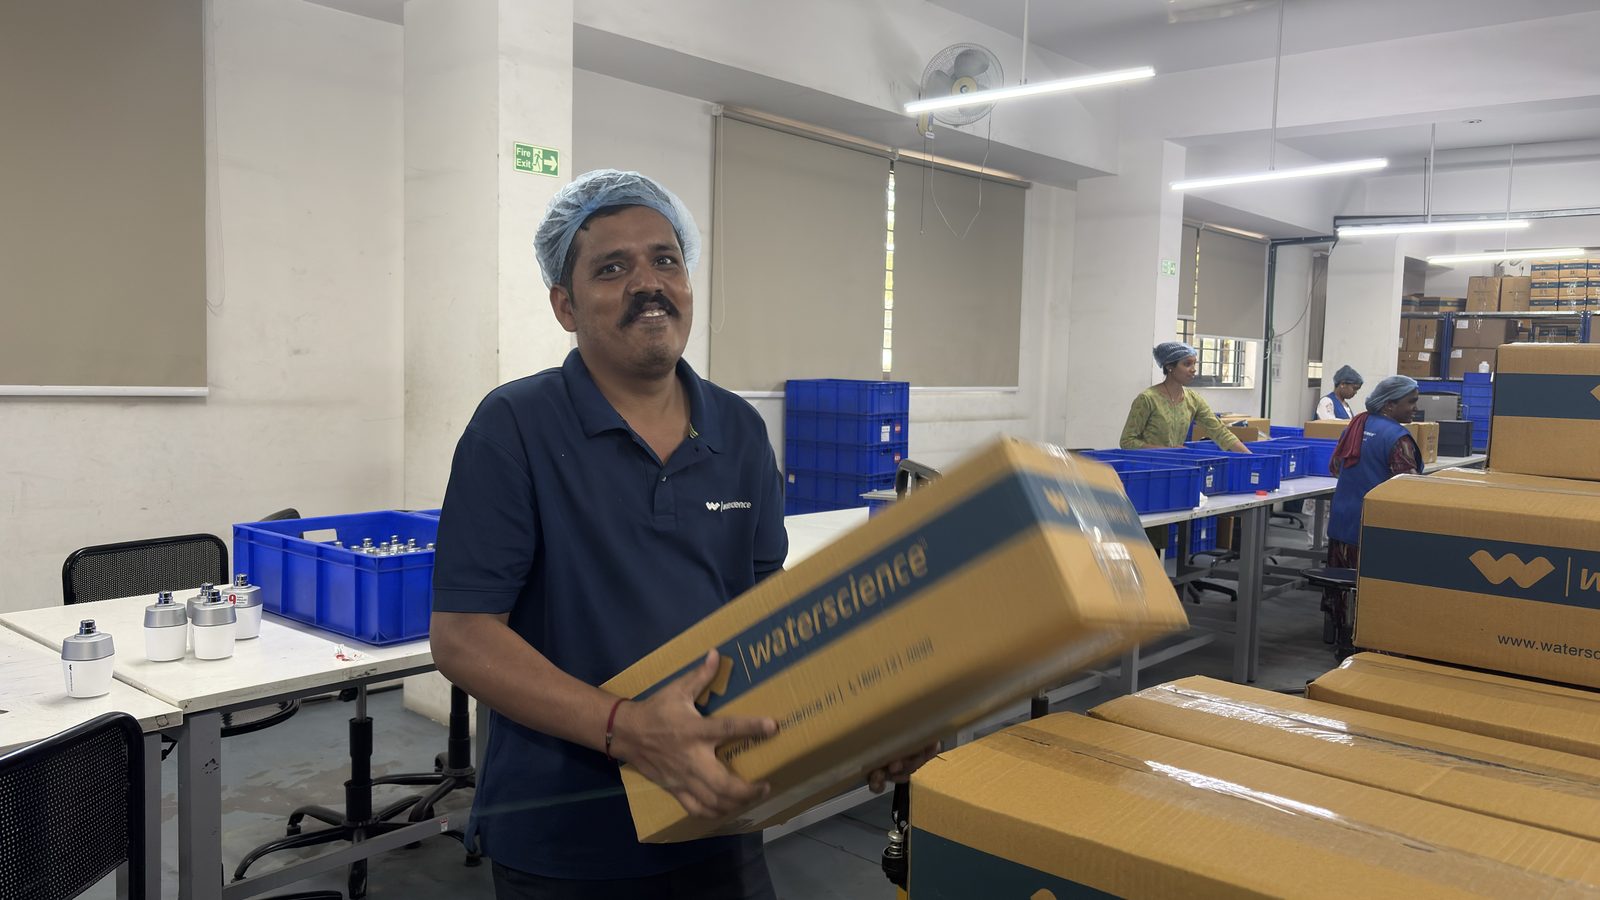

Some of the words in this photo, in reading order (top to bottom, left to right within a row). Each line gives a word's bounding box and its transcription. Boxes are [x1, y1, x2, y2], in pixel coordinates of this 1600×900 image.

[516, 147, 531, 157] Fire
[516, 158, 532, 168] Exit
[749, 543, 928, 670] waterscience
